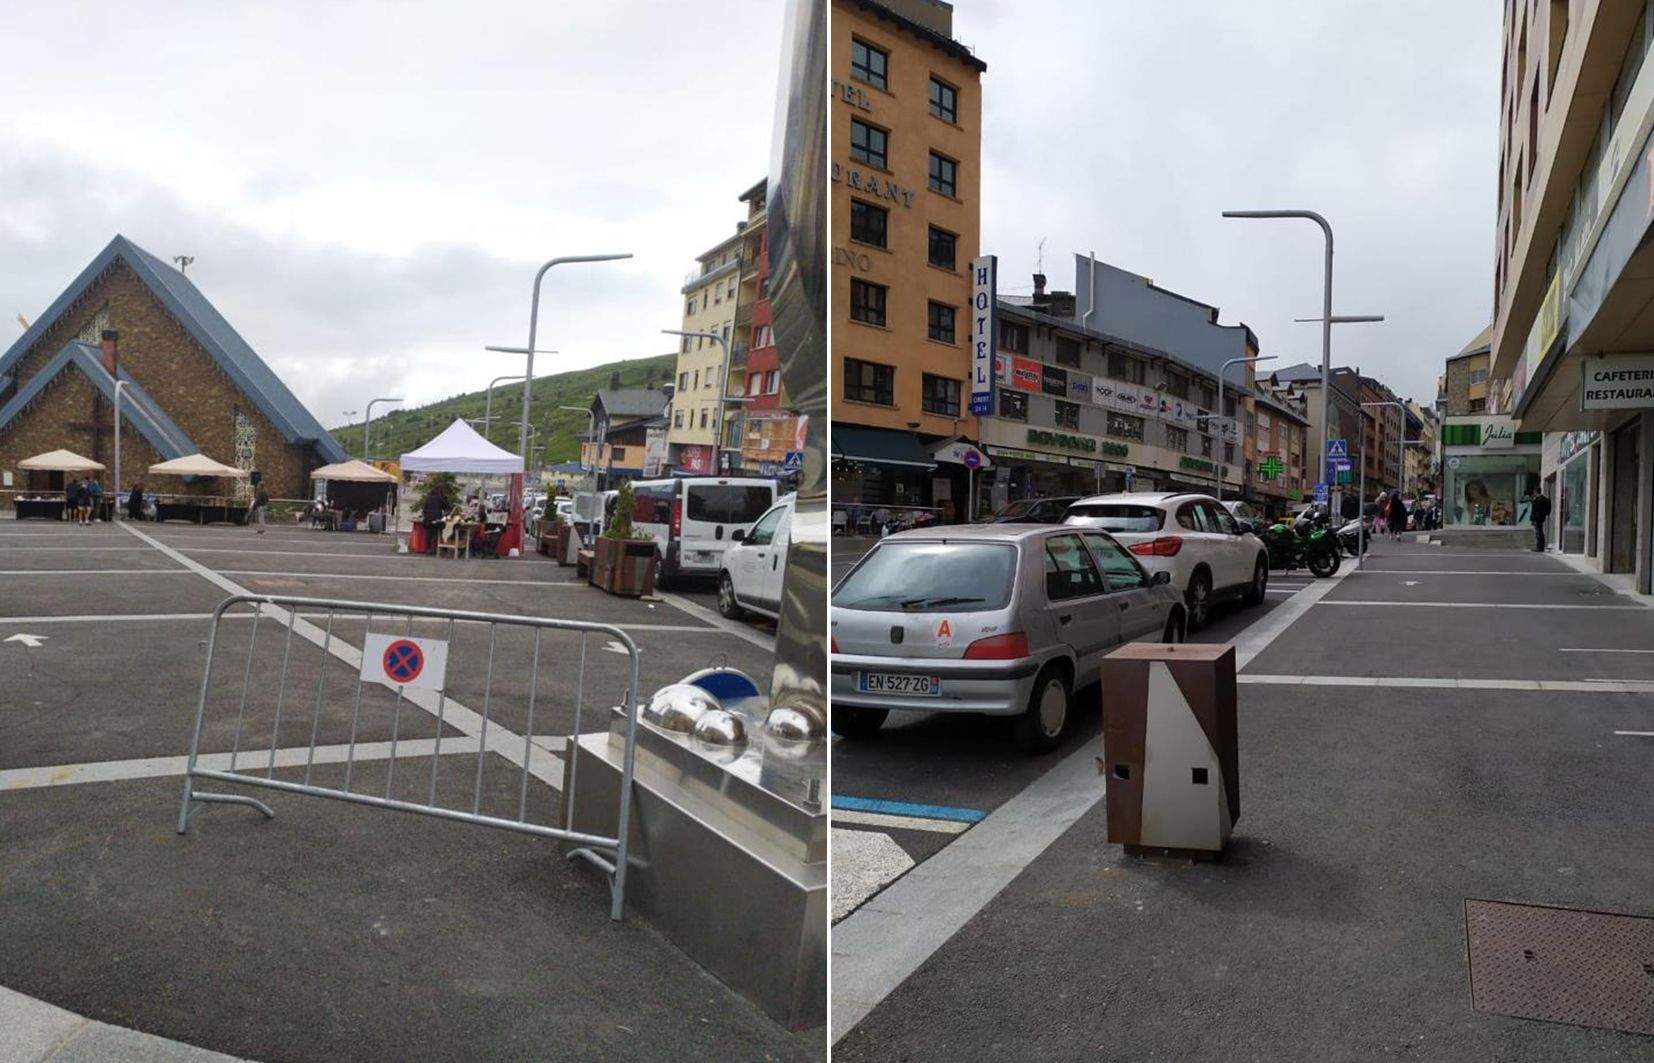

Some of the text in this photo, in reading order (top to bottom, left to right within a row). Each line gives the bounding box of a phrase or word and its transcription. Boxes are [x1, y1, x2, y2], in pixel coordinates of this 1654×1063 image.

[976, 267, 988, 384] HOTEL
[1593, 370, 1654, 382] CAFETERI
[1586, 388, 1654, 400] RESTAURA
[937, 620, 951, 637] A
